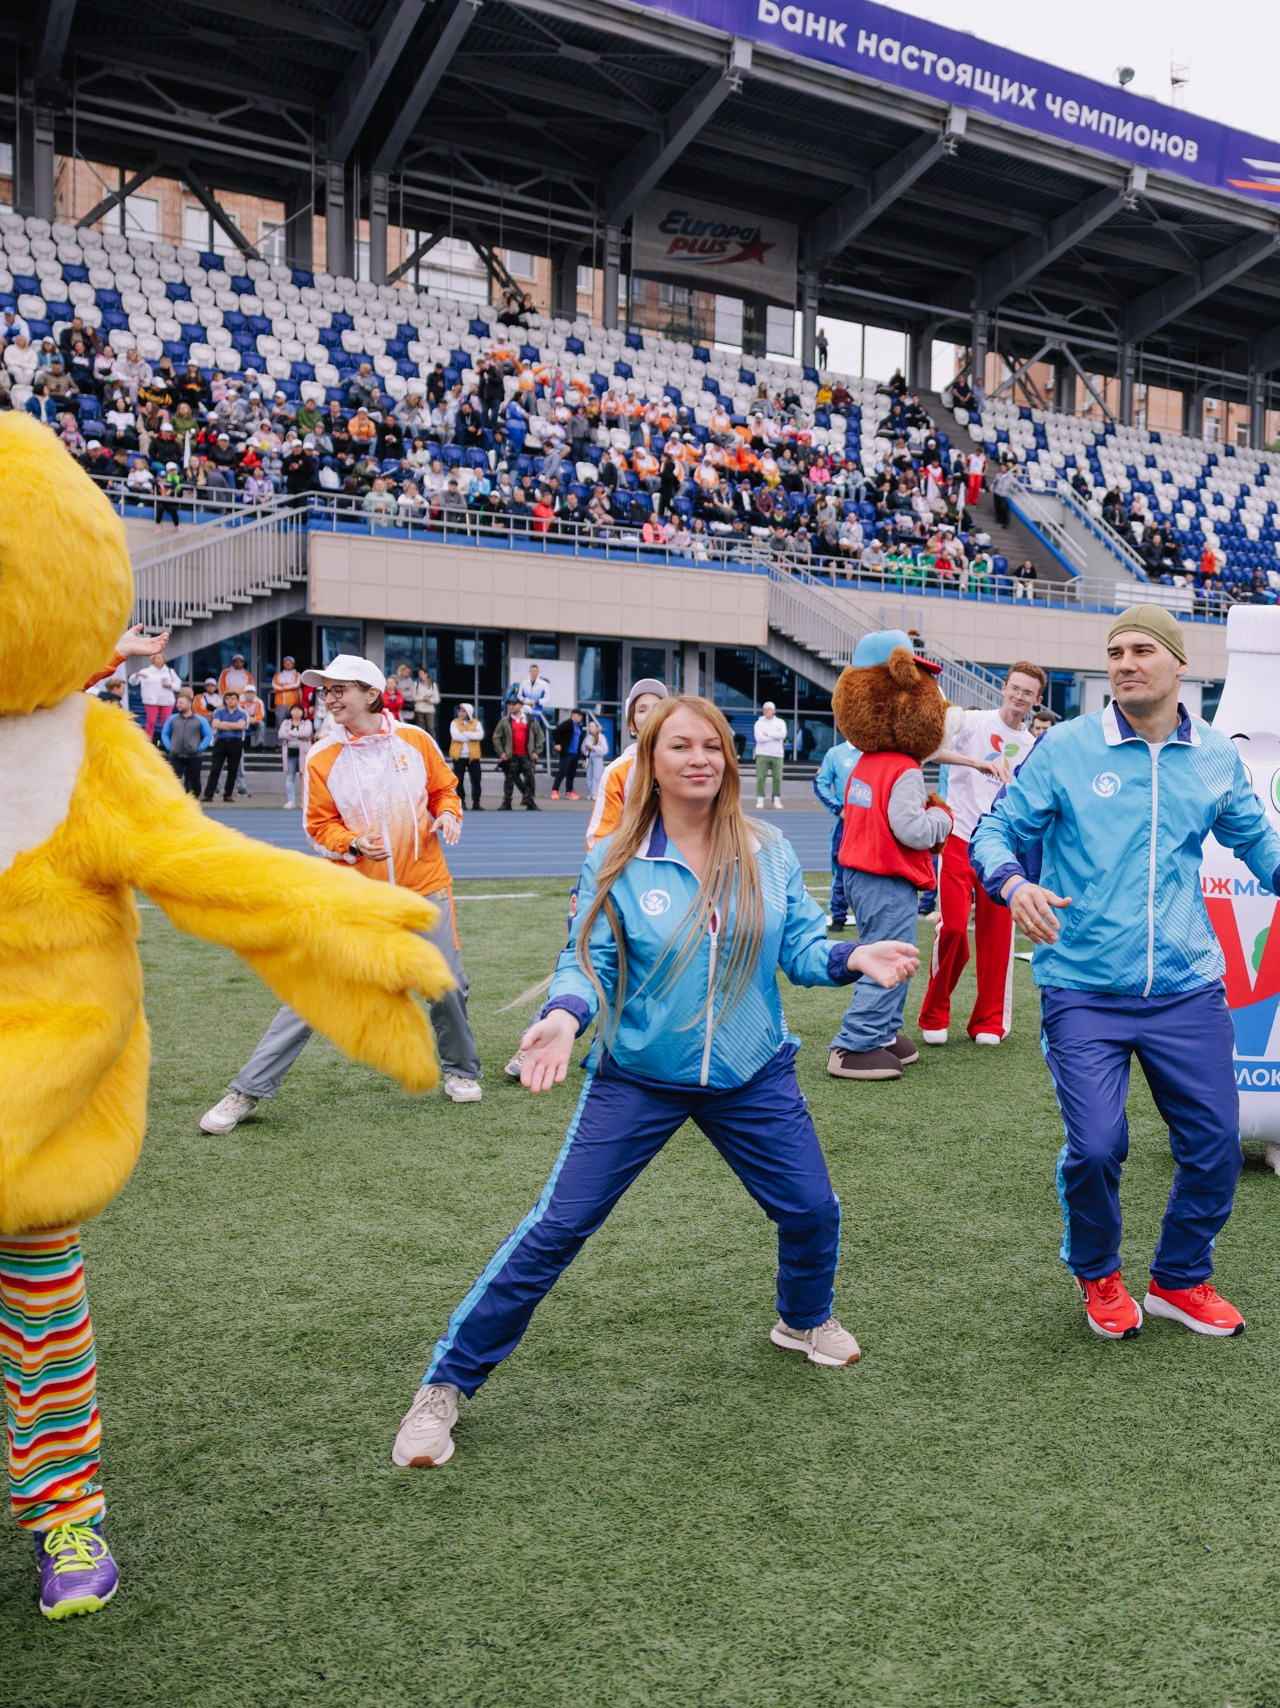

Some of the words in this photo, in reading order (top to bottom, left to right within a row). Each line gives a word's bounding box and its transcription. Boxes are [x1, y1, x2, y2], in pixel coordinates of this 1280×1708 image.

[758, 0, 848, 48] Банк
[857, 29, 1039, 111] настоящих
[1045, 92, 1199, 163] чемпионов
